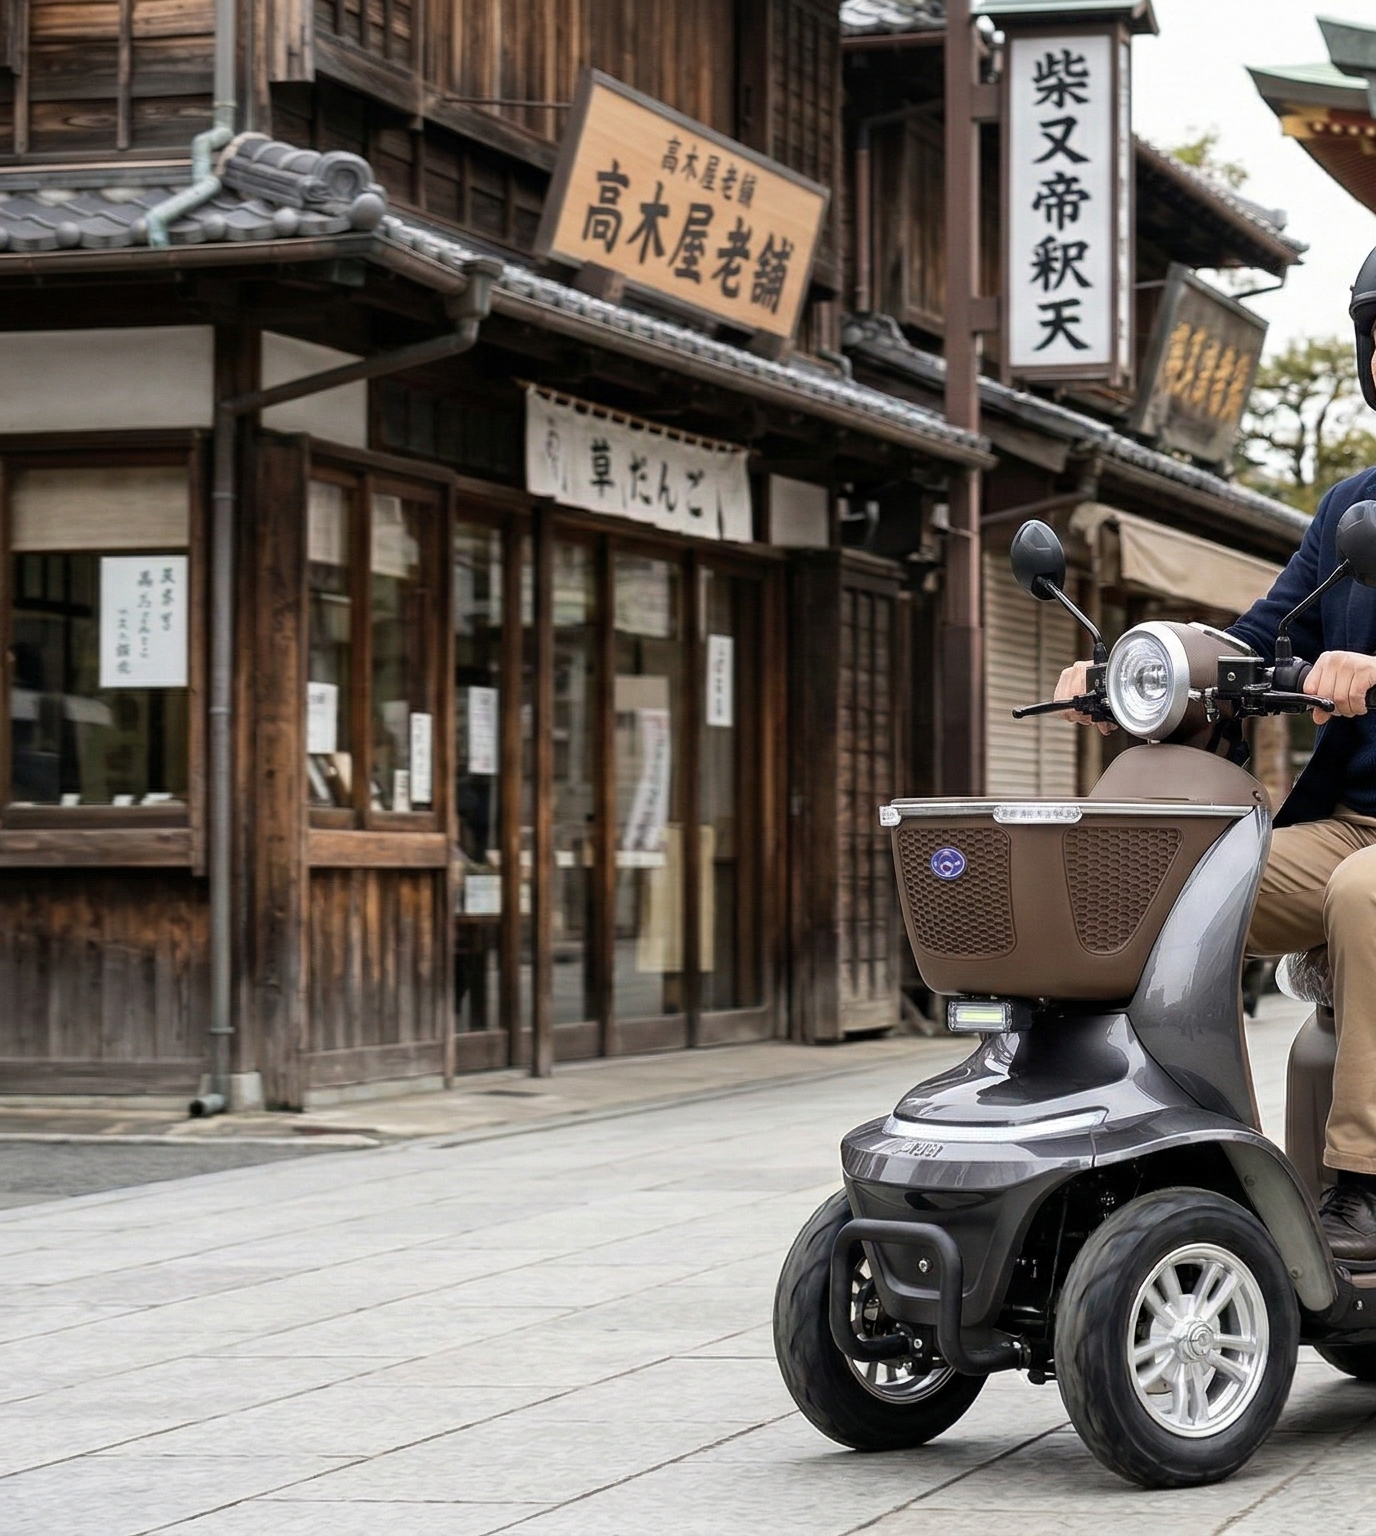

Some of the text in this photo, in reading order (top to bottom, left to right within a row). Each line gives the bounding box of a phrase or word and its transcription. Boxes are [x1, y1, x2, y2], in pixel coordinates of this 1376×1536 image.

[582, 158, 794, 315] 高木屋老舗
[1030, 49, 1093, 352] 柴又帝釈天
[590, 438, 704, 517] 草だんご
